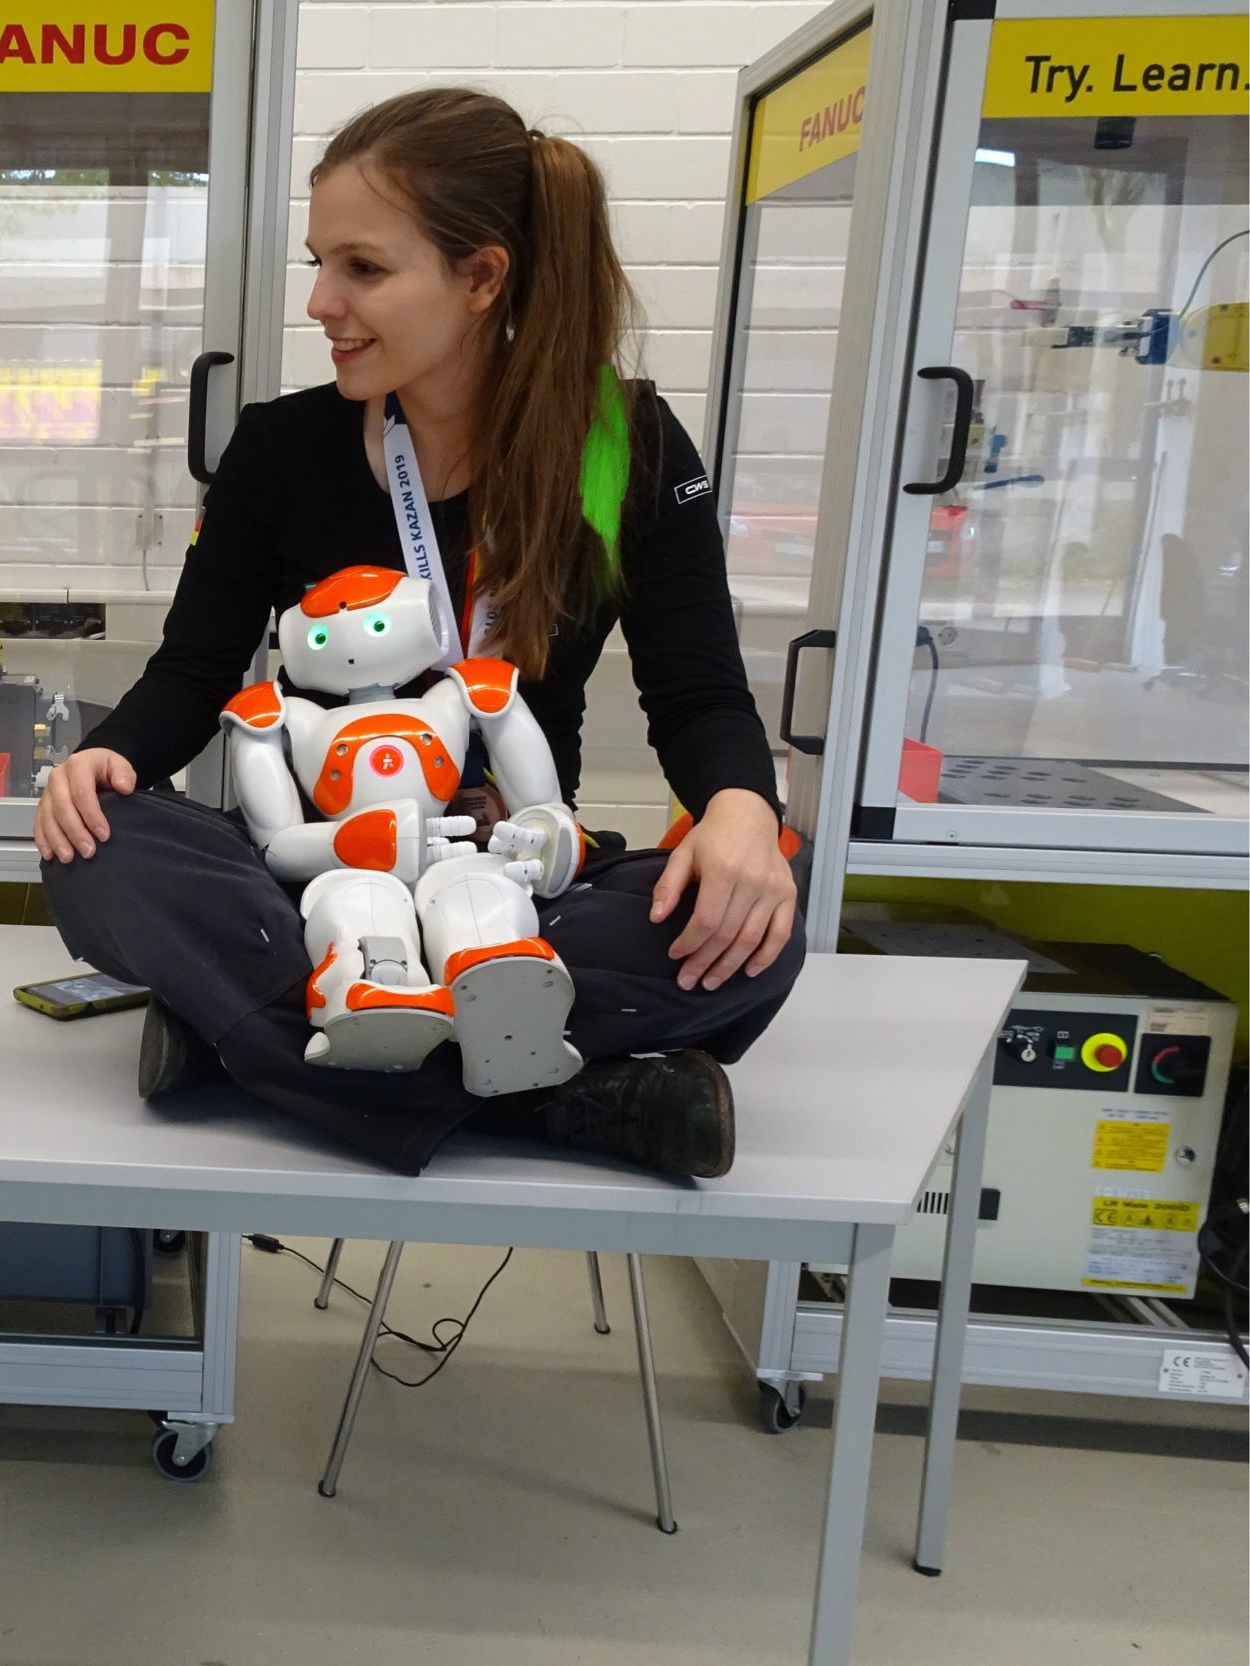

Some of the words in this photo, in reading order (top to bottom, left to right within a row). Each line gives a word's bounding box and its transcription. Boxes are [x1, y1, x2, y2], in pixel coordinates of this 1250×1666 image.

[1025, 55, 1093, 103] Try.
[1113, 54, 1250, 92] Learn.
[799, 86, 865, 152] FANUC
[394, 455, 410, 488] 2019
[402, 491, 422, 541] KAZAN
